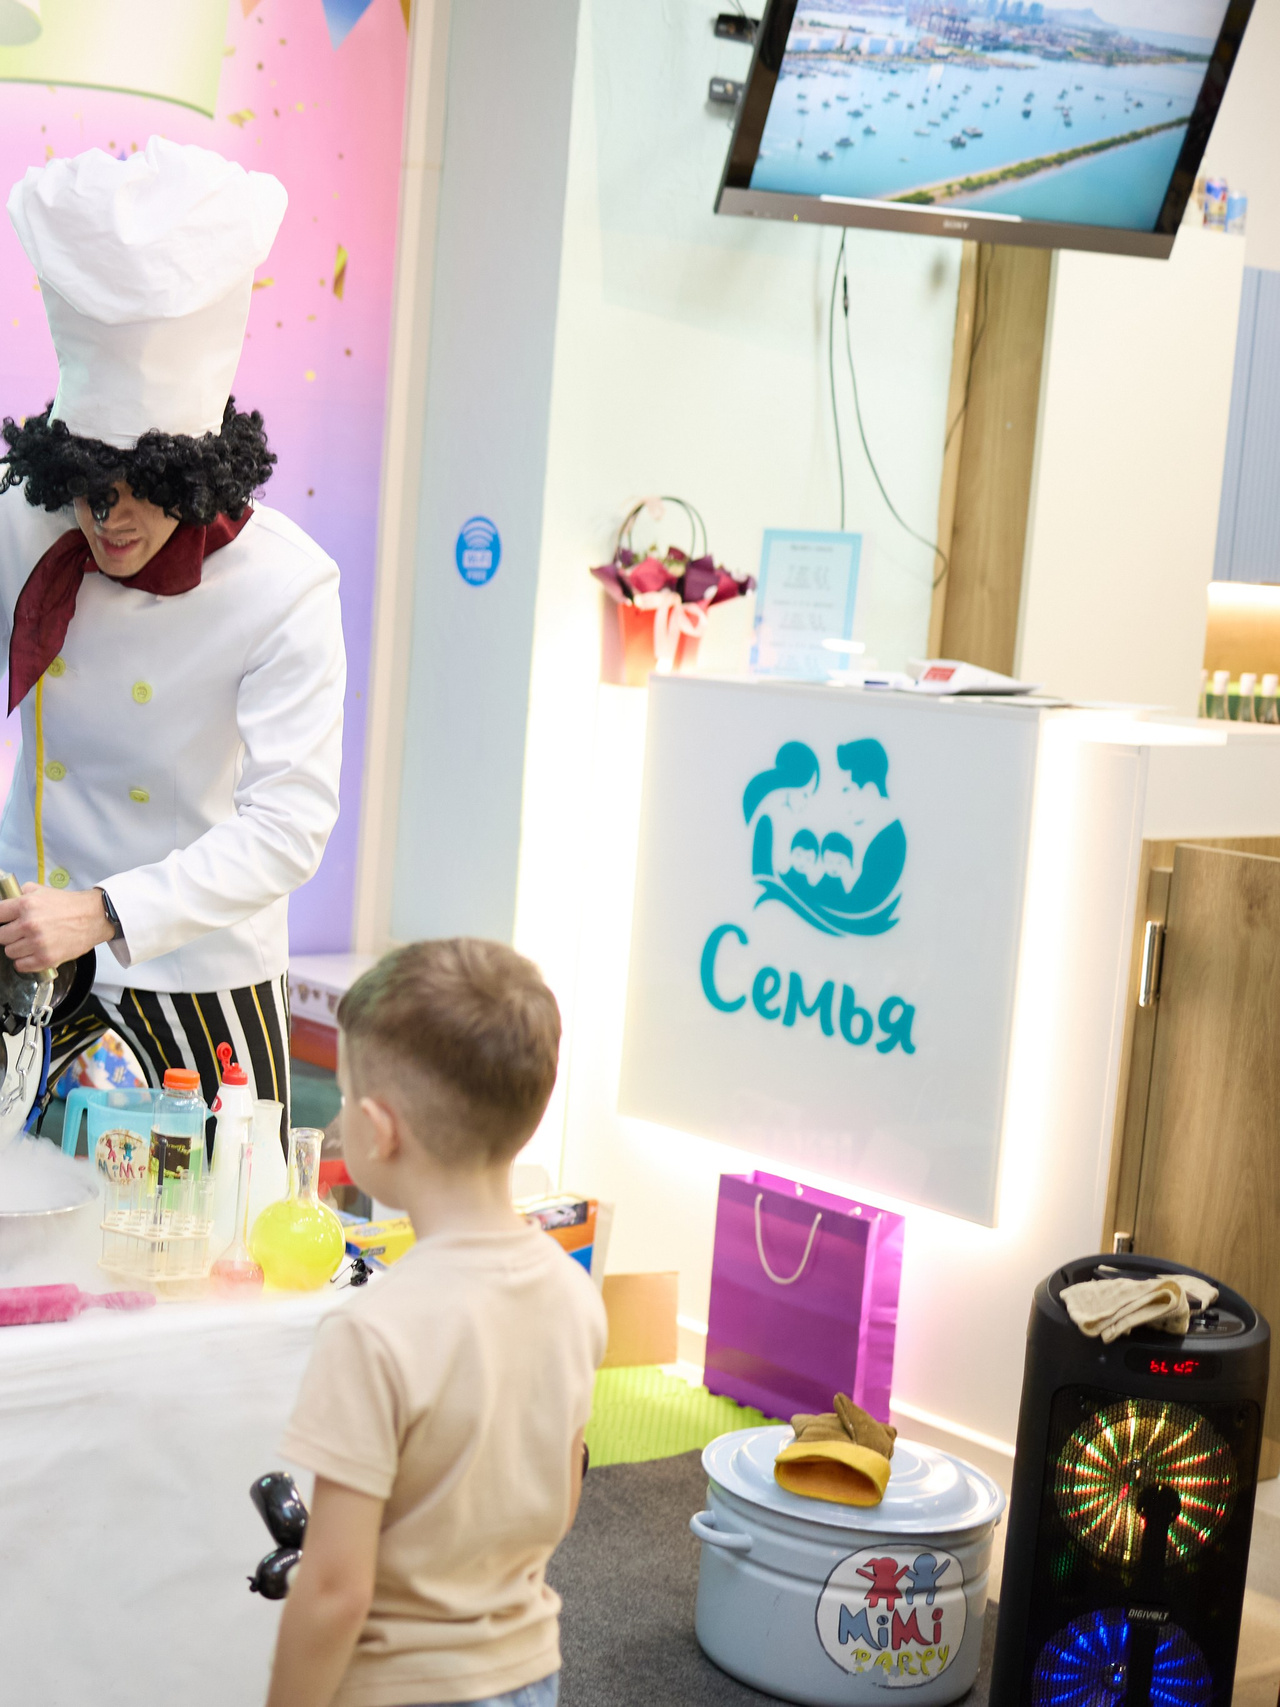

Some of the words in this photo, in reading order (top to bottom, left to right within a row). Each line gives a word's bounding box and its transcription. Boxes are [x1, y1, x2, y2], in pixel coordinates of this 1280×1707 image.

[700, 924, 917, 1055] Семья
[837, 1603, 944, 1651] MiMi
[1127, 1608, 1169, 1622] DIGIVOLT
